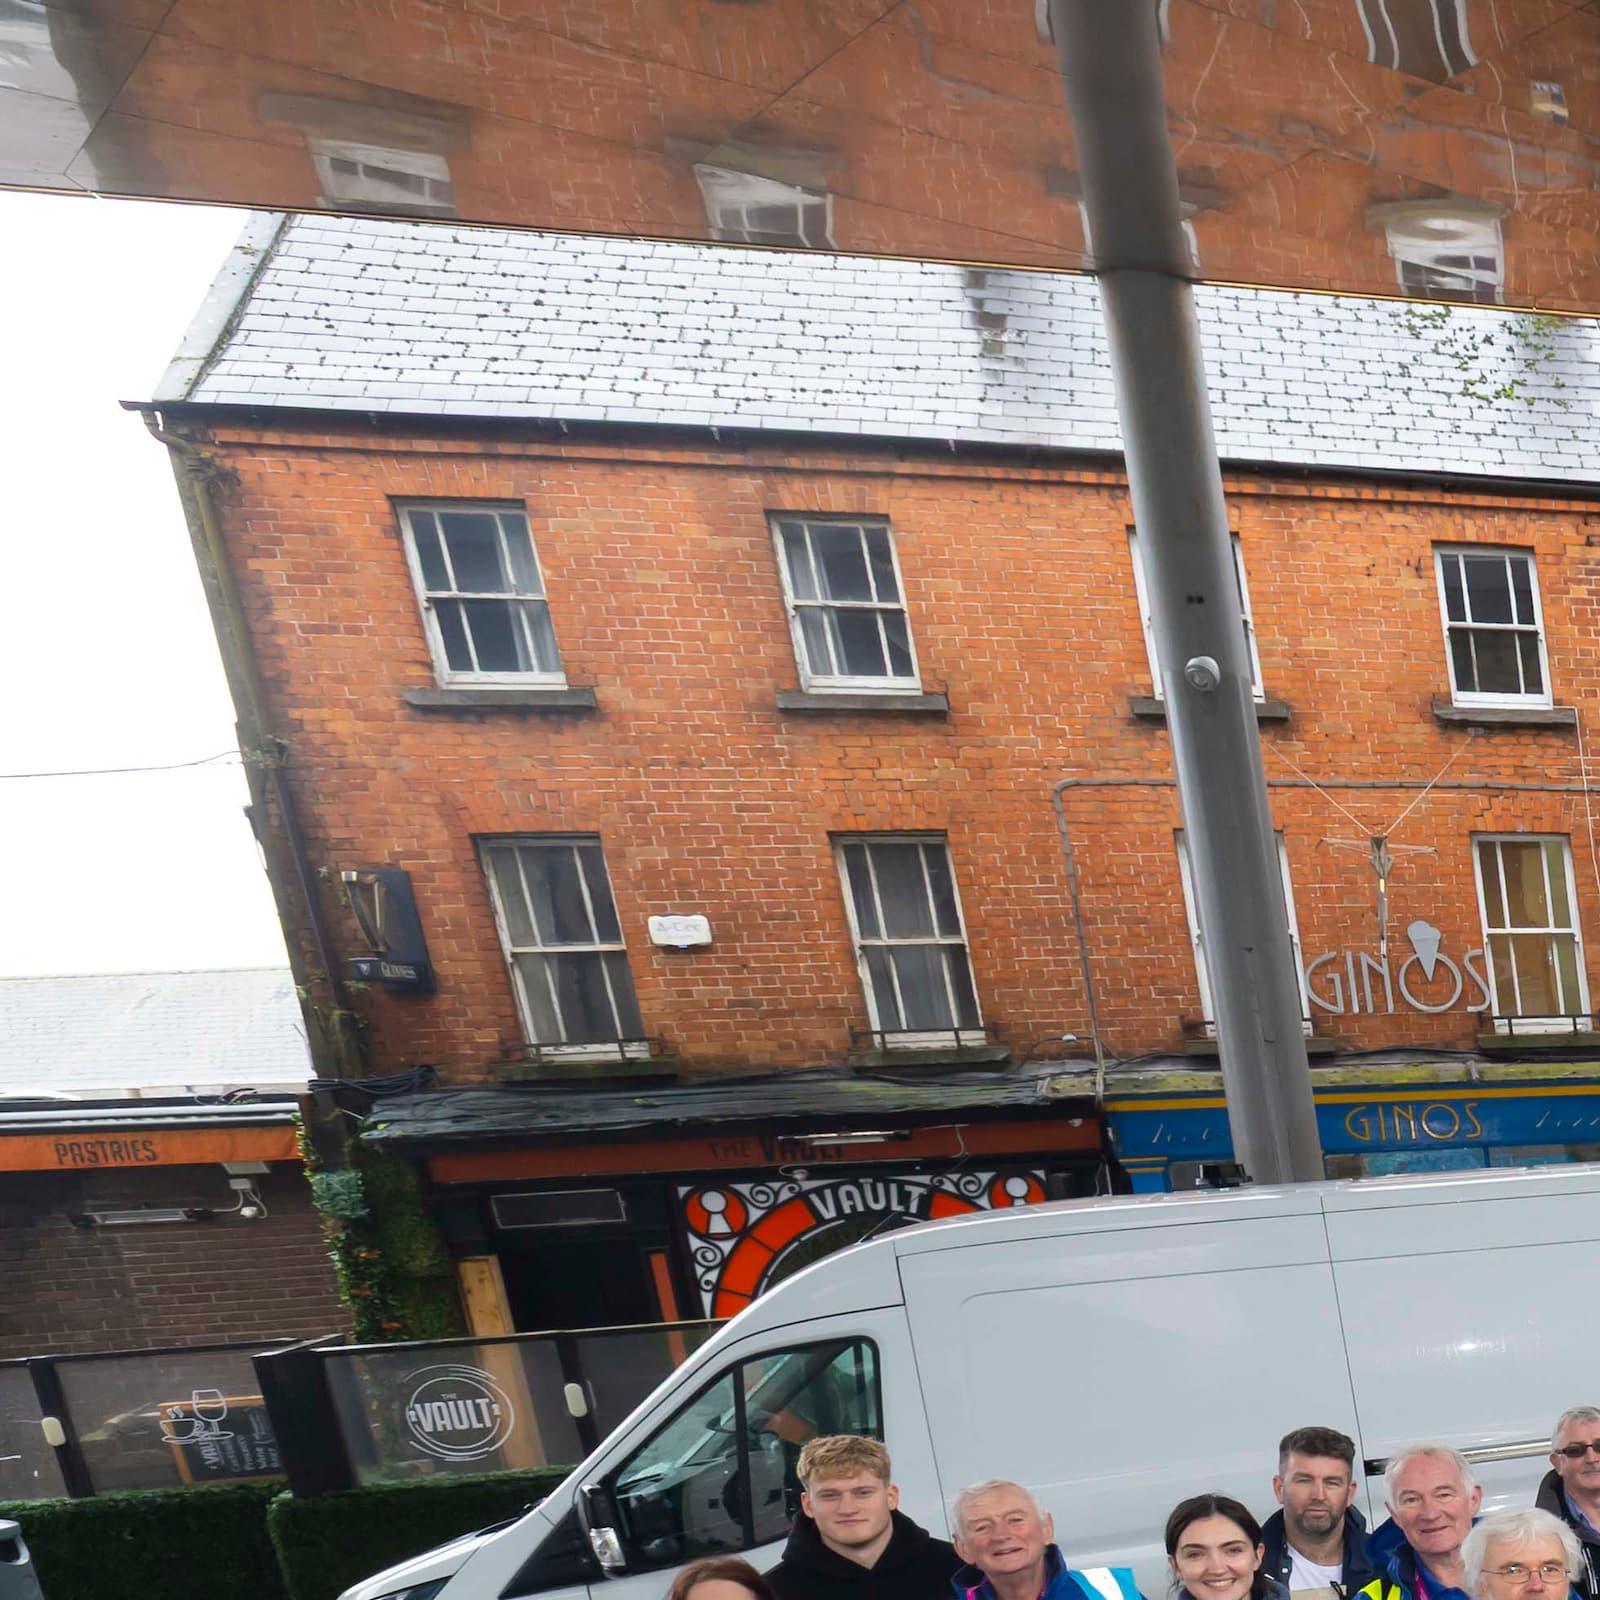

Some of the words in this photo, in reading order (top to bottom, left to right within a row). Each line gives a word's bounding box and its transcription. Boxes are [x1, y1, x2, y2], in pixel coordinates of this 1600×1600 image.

[1306, 948, 1490, 1014] GINOS
[1345, 1103, 1483, 1141] GINOS
[55, 1140, 158, 1166] PASTRIES
[414, 1398, 492, 1433] VAULT
